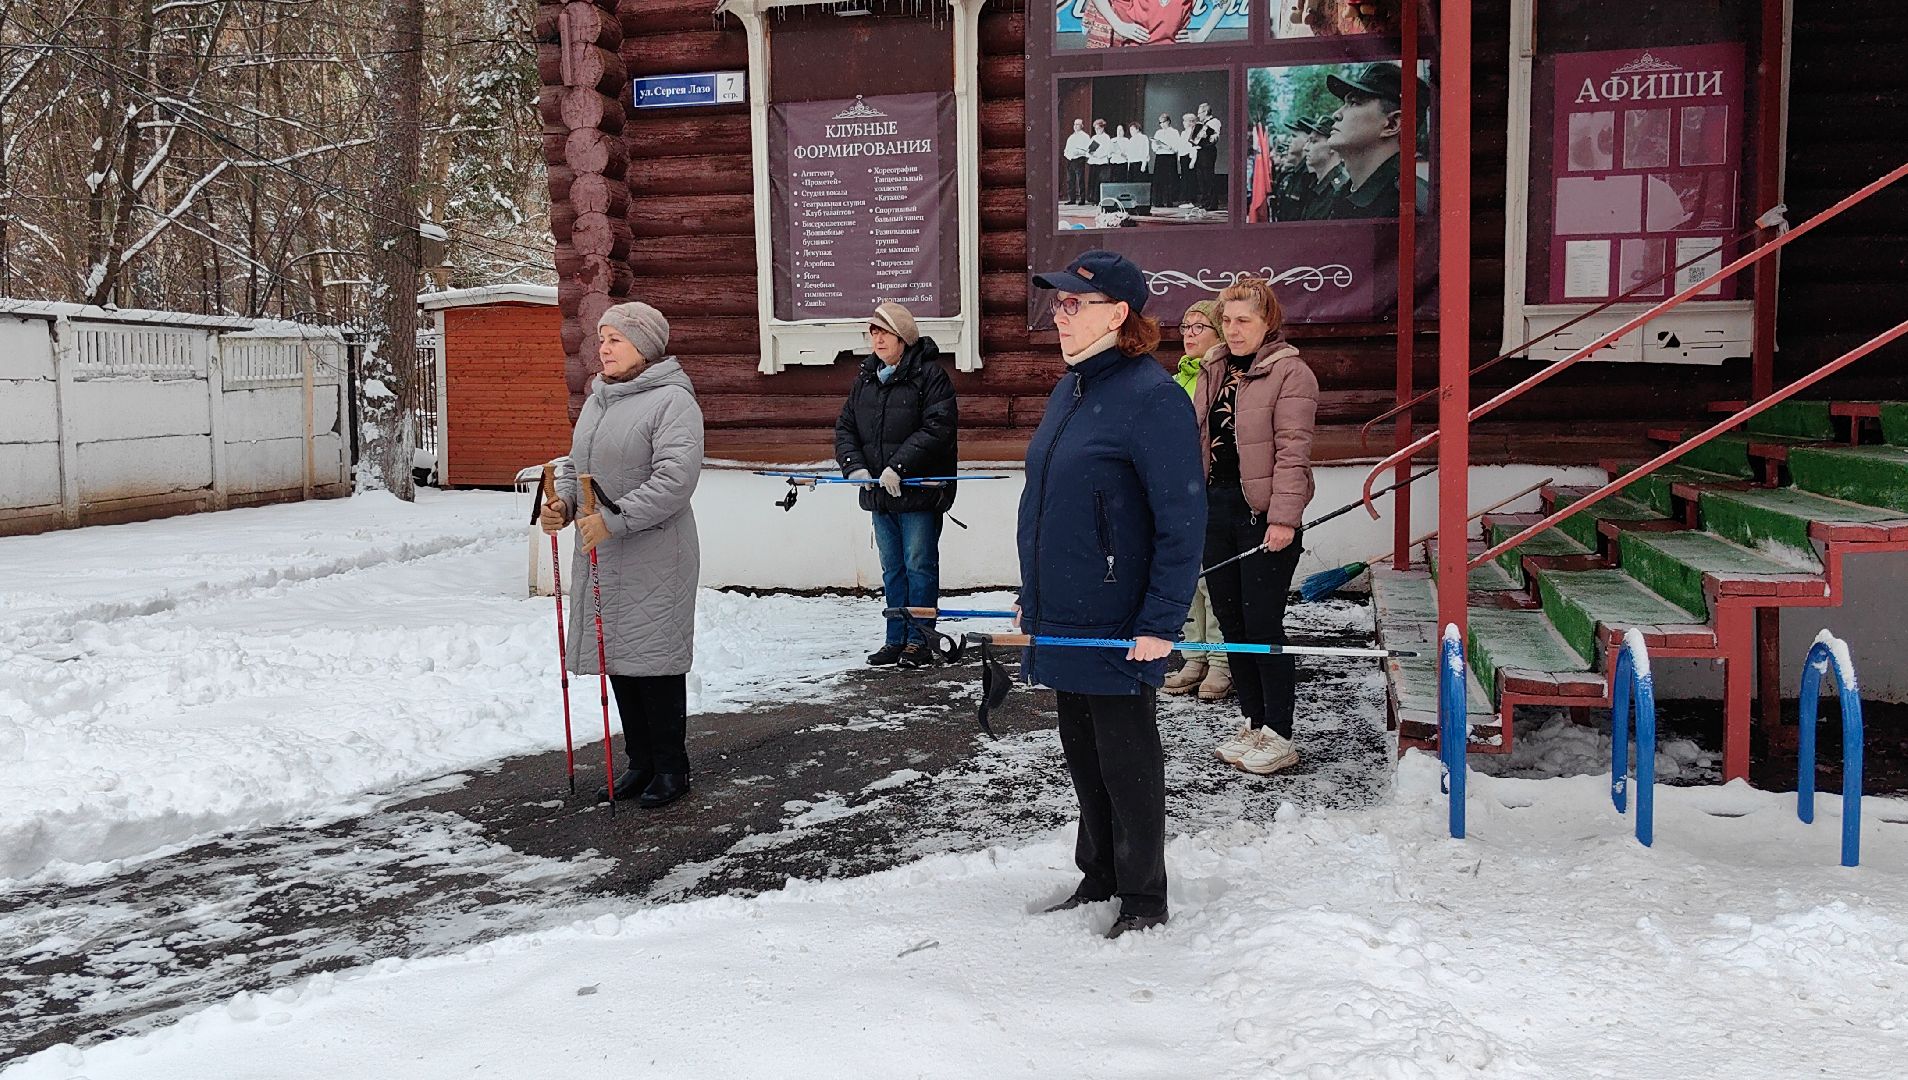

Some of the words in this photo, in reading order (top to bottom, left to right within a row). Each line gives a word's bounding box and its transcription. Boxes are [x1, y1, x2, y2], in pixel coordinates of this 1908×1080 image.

[727, 77, 734, 90] 7
[1575, 70, 1723, 104] АФИШИ
[688, 84, 710, 95] Лазо
[723, 92, 738, 100] стр.
[825, 121, 898, 138] КЛУБНЫЕ
[793, 139, 932, 159] ФОРМИРОВАНИЯ
[873, 165, 918, 175] Хореография
[873, 174, 923, 183] Танцевальный
[801, 190, 825, 198] Студия
[802, 201, 842, 209] Театральная
[874, 205, 917, 215] Спортивный
[874, 215, 903, 223] бальный
[802, 220, 856, 228] Бисероплетение
[875, 228, 920, 236] Развивающая
[875, 238, 899, 246] группа
[803, 249, 833, 257] Декупаж
[888, 245, 920, 253] малышей
[804, 260, 835, 269] Аэробика
[876, 260, 914, 268] Творческая
[804, 271, 820, 280] Йога
[876, 269, 912, 277] мастерская
[804, 281, 835, 289] Лечебная
[876, 282, 908, 291] Цирковая
[909, 281, 932, 290] студия
[920, 294, 933, 302] бой
